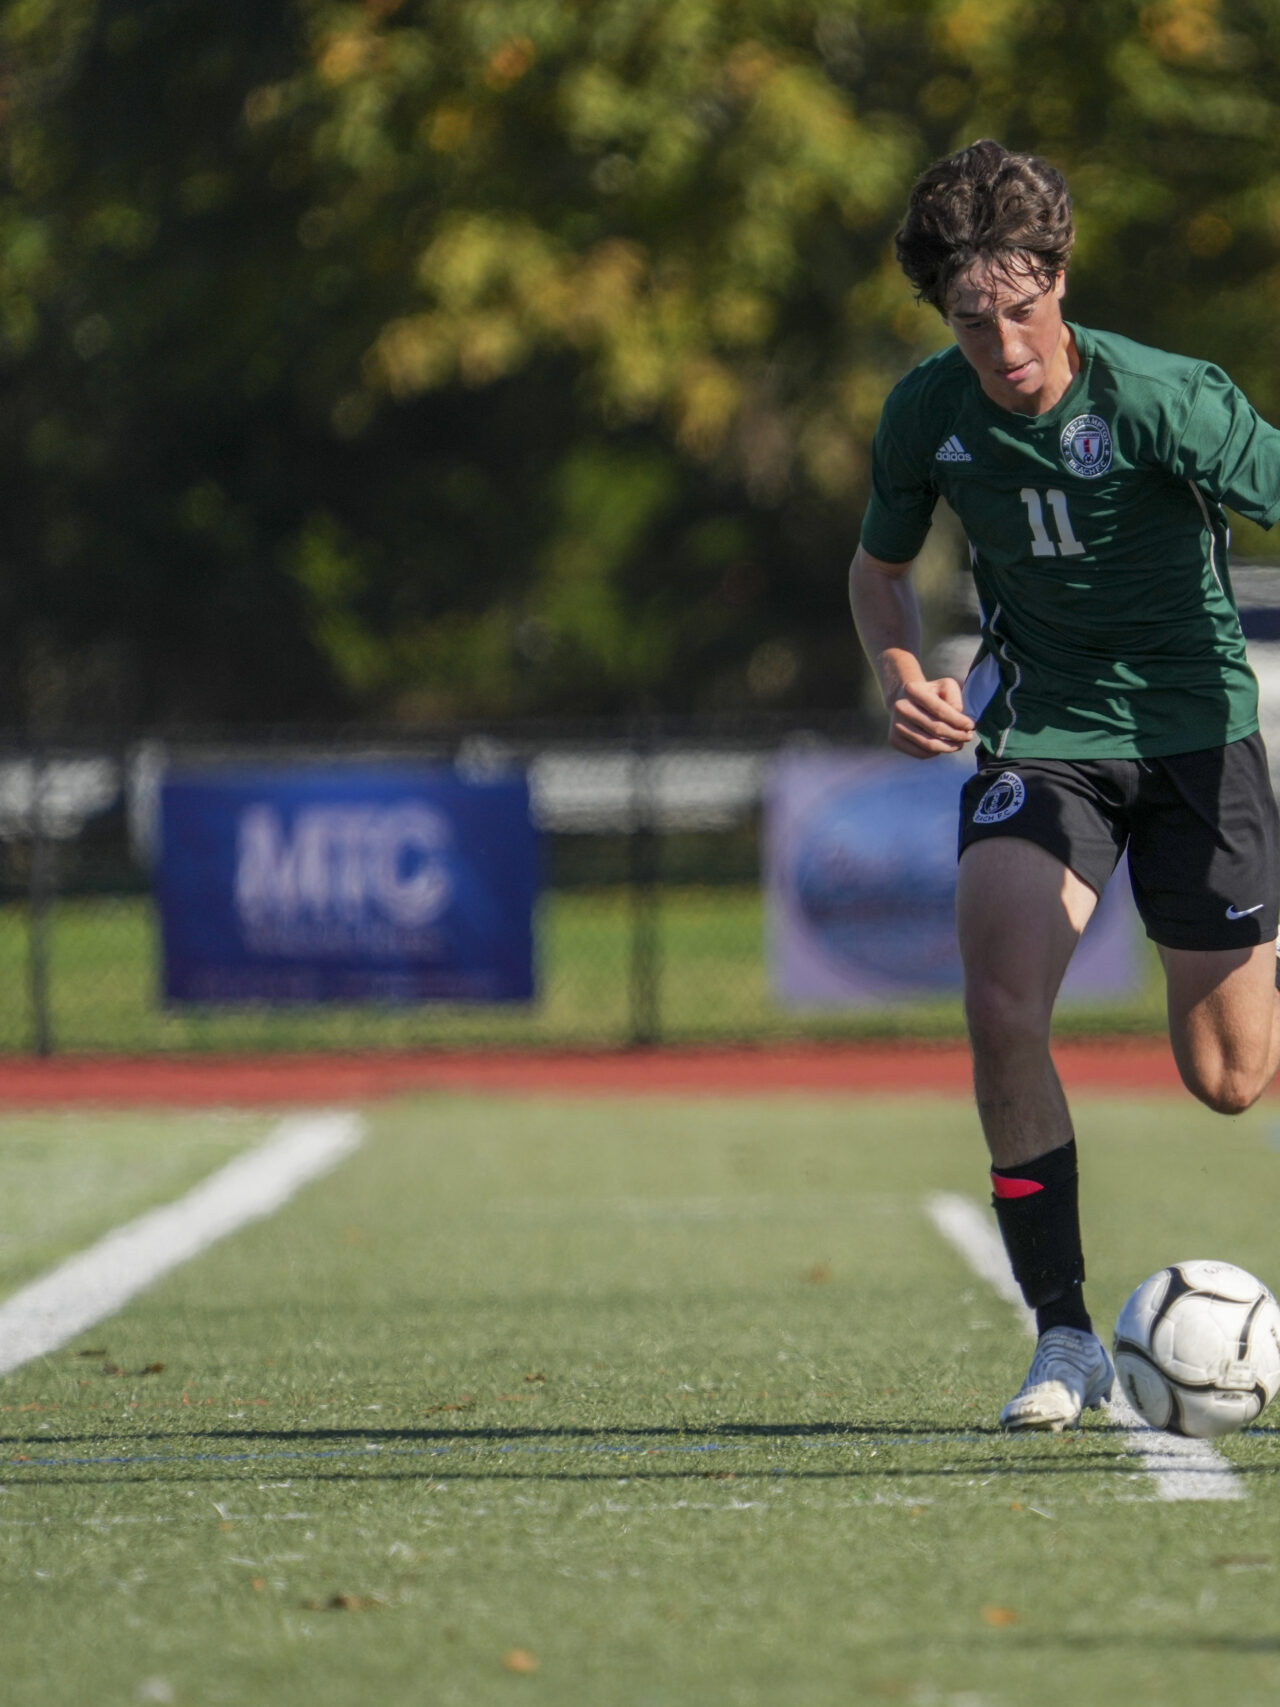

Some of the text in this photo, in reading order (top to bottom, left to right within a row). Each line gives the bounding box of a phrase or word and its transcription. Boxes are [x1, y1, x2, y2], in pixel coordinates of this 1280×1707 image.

[1063, 417, 1110, 446] WESTHAMPTON
[935, 451, 972, 462] adidas
[1069, 459, 1096, 475] BEACH
[1019, 487, 1087, 557] 11
[236, 801, 454, 927] MTC
